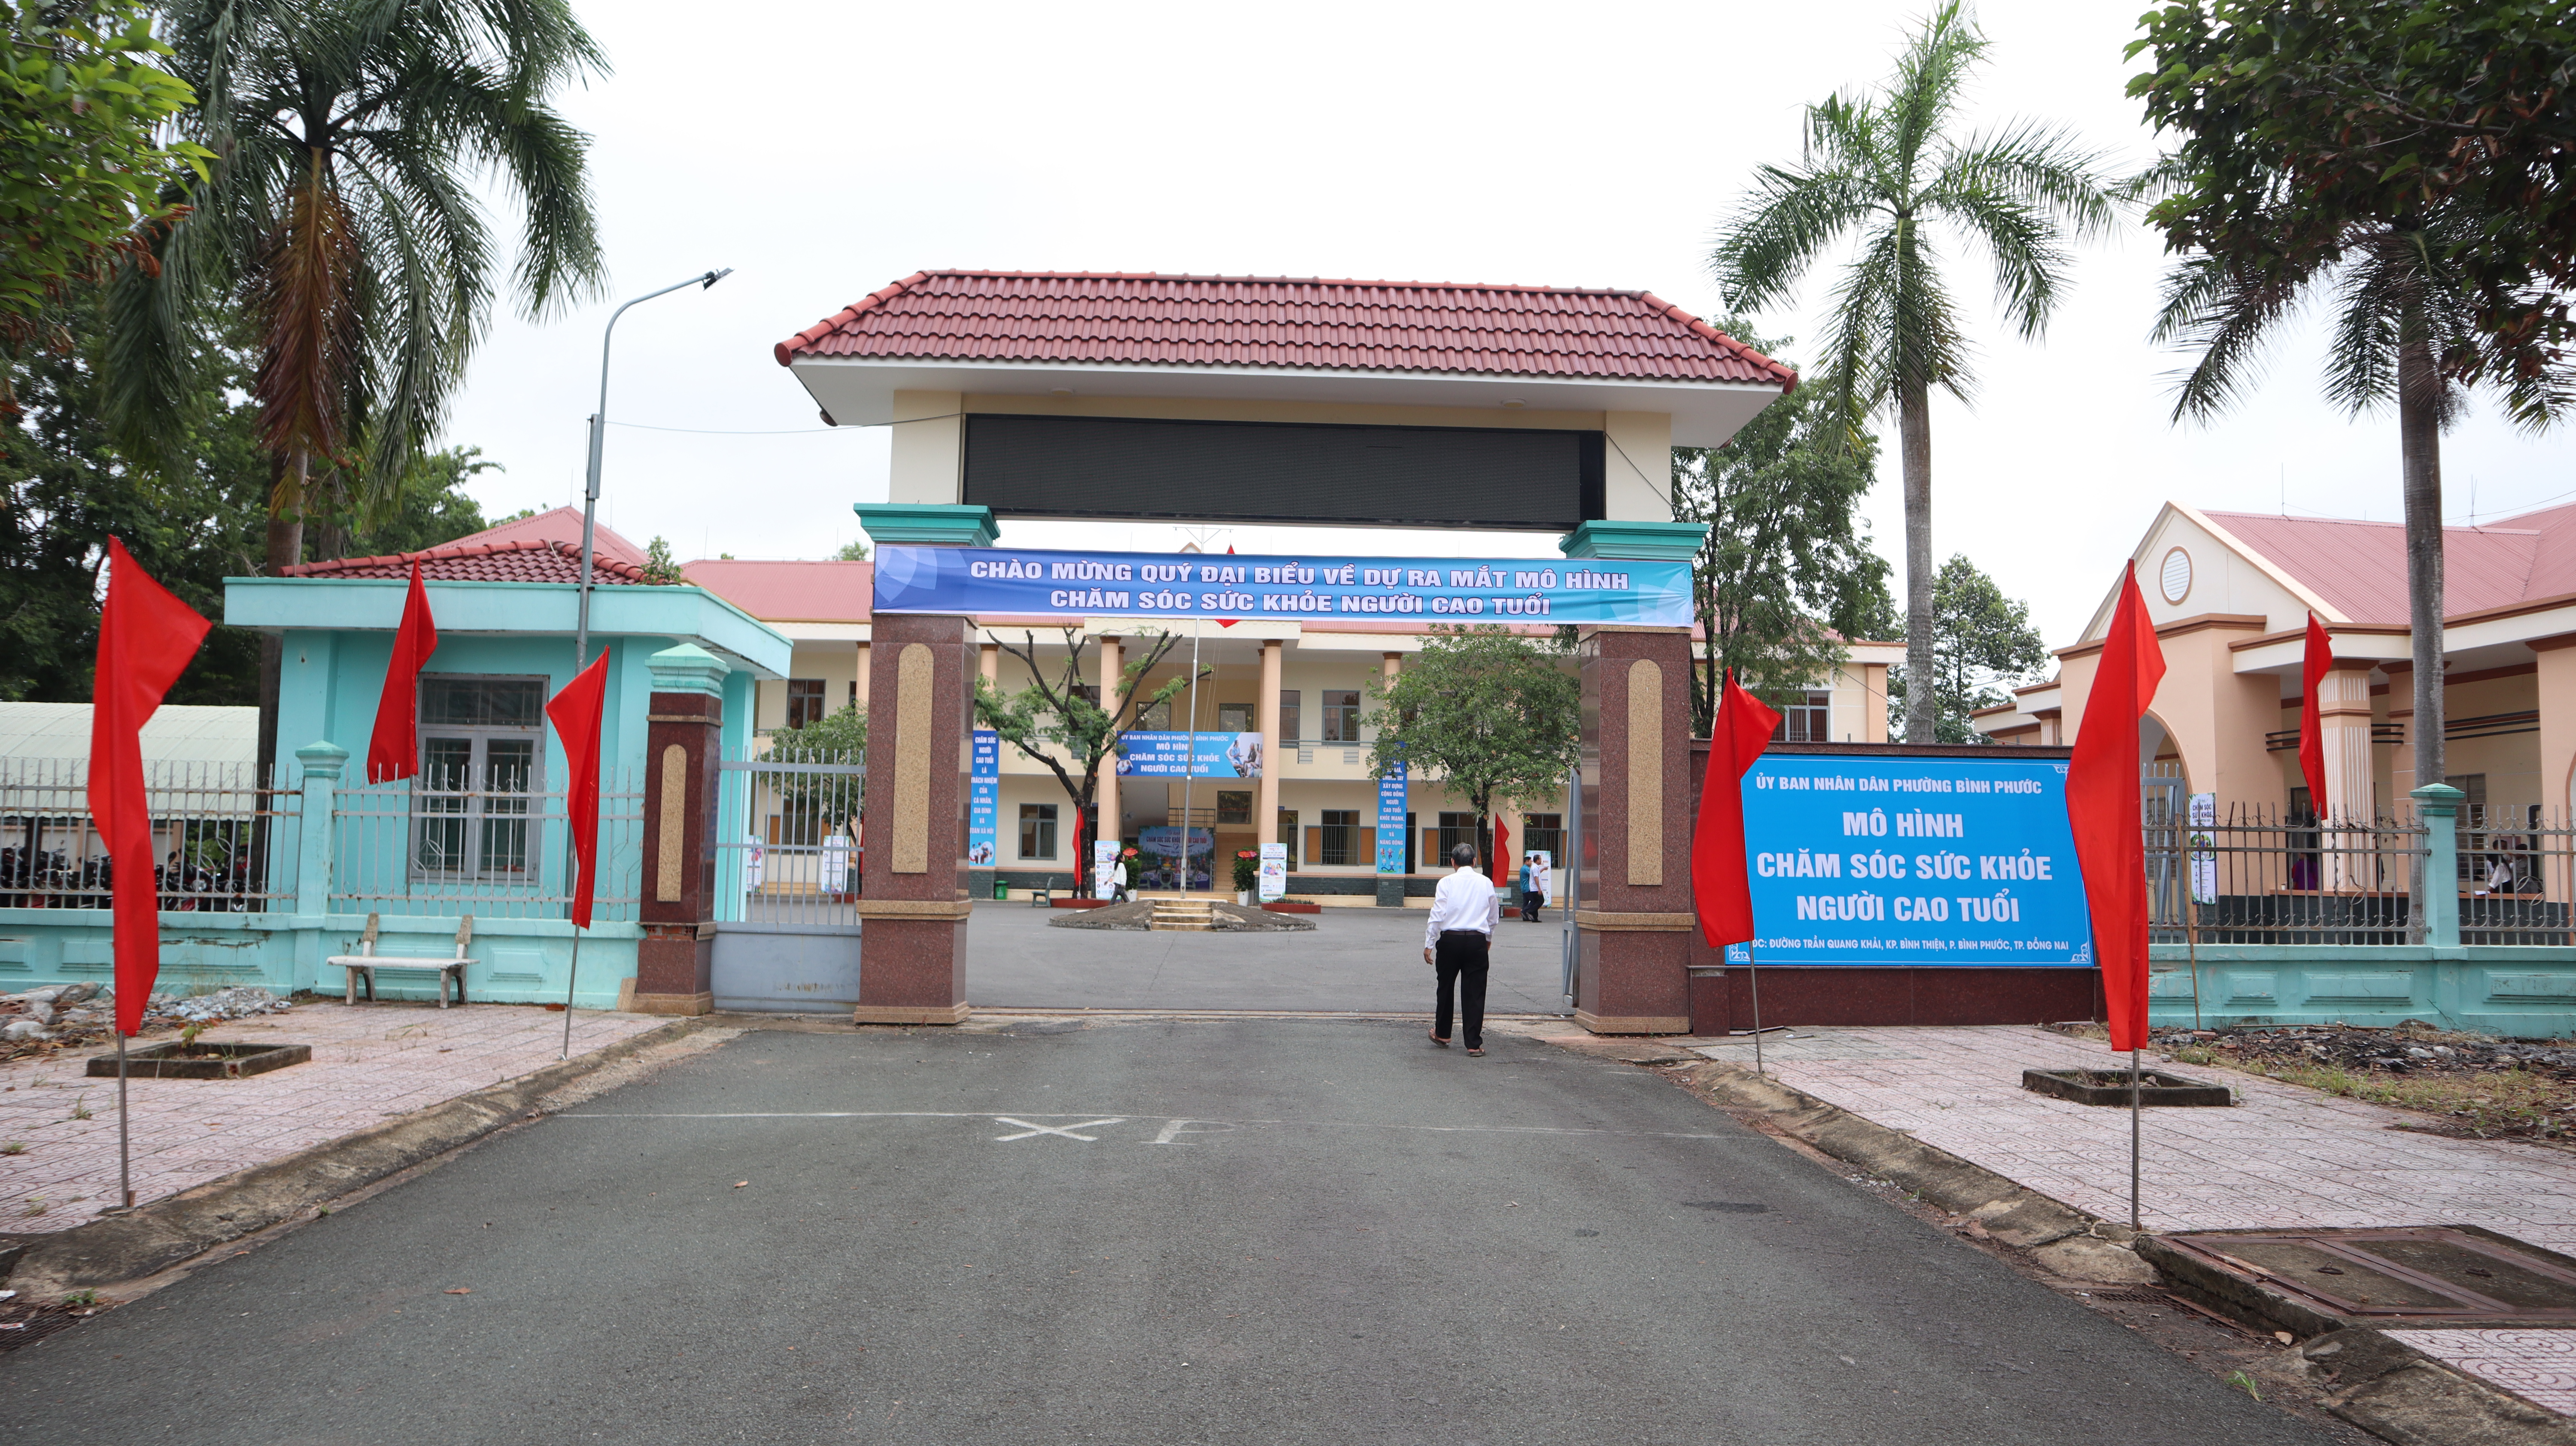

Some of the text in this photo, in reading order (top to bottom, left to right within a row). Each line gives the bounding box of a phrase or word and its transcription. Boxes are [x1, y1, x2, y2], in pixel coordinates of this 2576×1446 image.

[971, 559, 1628, 590] CHÀO MỪNG QUÝ ĐẠI BIỂU VỀ DỰ RA MẮT MÔ HÌNH
[1051, 588, 1551, 614] CHĂM SÓC SỨC KHỎE NGƯỜI CAO TUỔI
[975, 735, 987, 744] CHĂM
[1156, 742, 1170, 750] MÔ
[1130, 752, 1155, 761] CHĂM
[1157, 753, 1175, 762] SÓC
[1197, 752, 1220, 762] KHỎE
[1141, 764, 1167, 772] NGƯỜI
[1191, 763, 1209, 773] TUỔI
[1756, 772, 2041, 793] ỦY BAN NHÂN DÂN PHƯỜNG BÌNH PHƯỚC
[1843, 808, 1963, 837] MÔ HÌNH
[1757, 848, 2052, 880] CHĂM SÓC SỨC KHỎE
[1797, 888, 2019, 922] NGƯỜI CAO TUỔI
[1769, 937, 1801, 948] ĐƯỜNG
[1803, 935, 1825, 948] TRẦN
[1828, 940, 1858, 948] QUANG
[1861, 937, 1883, 950] KHẢI,
[1886, 940, 1897, 948] KP.
[1900, 938, 1920, 949] BÌNH
[1922, 938, 1947, 951] THIỆN,
[1950, 941, 1956, 949] P.
[1958, 939, 1978, 949] BÌNH
[1980, 939, 2012, 951] PHƯỚC,
[2014, 941, 2024, 949] TP.
[2027, 937, 2052, 950] ĐỒNG
